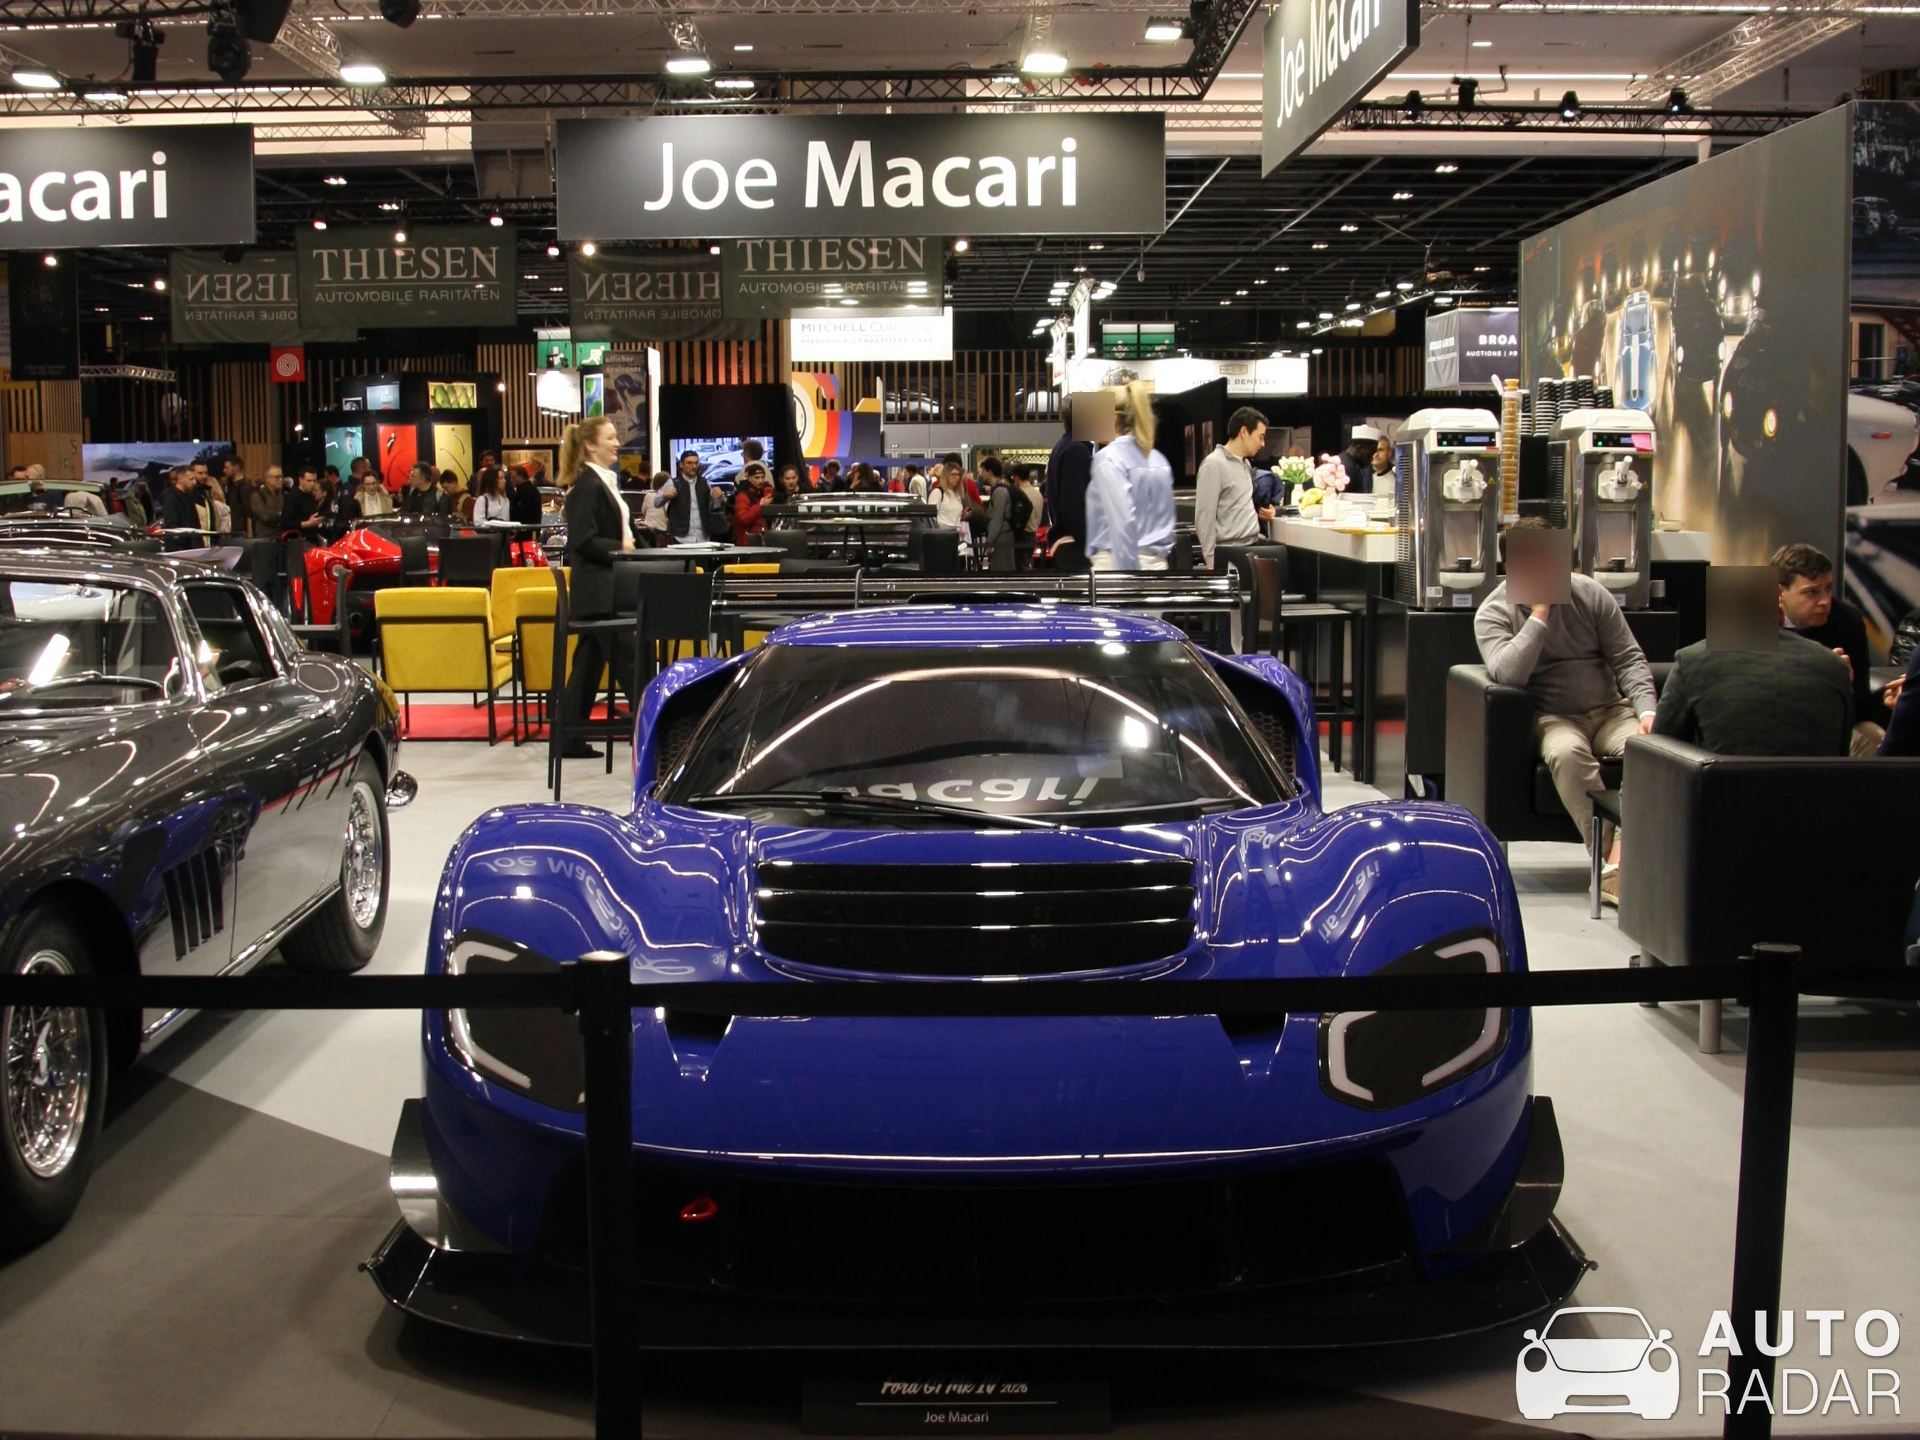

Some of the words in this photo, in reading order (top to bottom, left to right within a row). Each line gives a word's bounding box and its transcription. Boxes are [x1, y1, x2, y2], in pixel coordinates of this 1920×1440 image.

[1277, 36, 1305, 128] Joe
[1309, 0, 1380, 95] Maca
[643, 142, 777, 211] Joe
[805, 136, 1078, 208] Macari
[737, 237, 926, 271] THIESEN
[313, 246, 499, 281] THIESEN
[844, 279, 920, 293] RARITÄT
[315, 290, 413, 303] AUTOMOBILE
[419, 287, 500, 302] RARITÄTEN
[801, 322, 867, 332] MITCHELL
[1478, 334, 1518, 345] BROA
[924, 1411, 946, 1423] Joe
[948, 1411, 989, 1423] Macari
